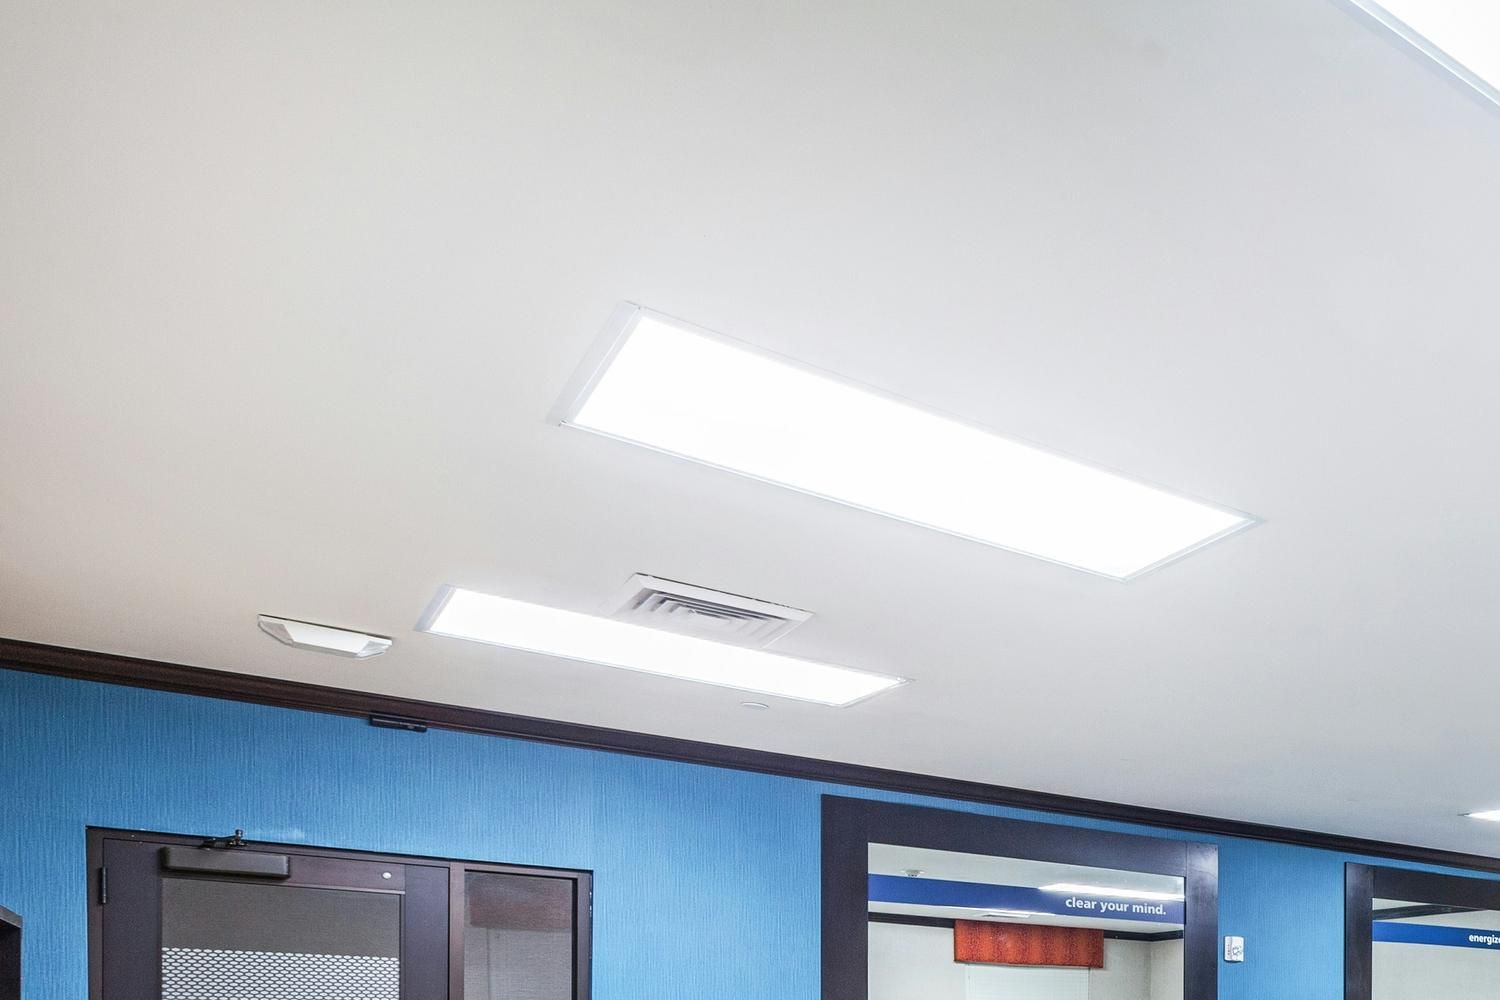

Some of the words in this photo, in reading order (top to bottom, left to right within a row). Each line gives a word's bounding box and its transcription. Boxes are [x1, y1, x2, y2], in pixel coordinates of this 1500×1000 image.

[1065, 897, 1097, 909] clear
[1100, 902, 1129, 913] your
[1132, 903, 1167, 915] mind.
